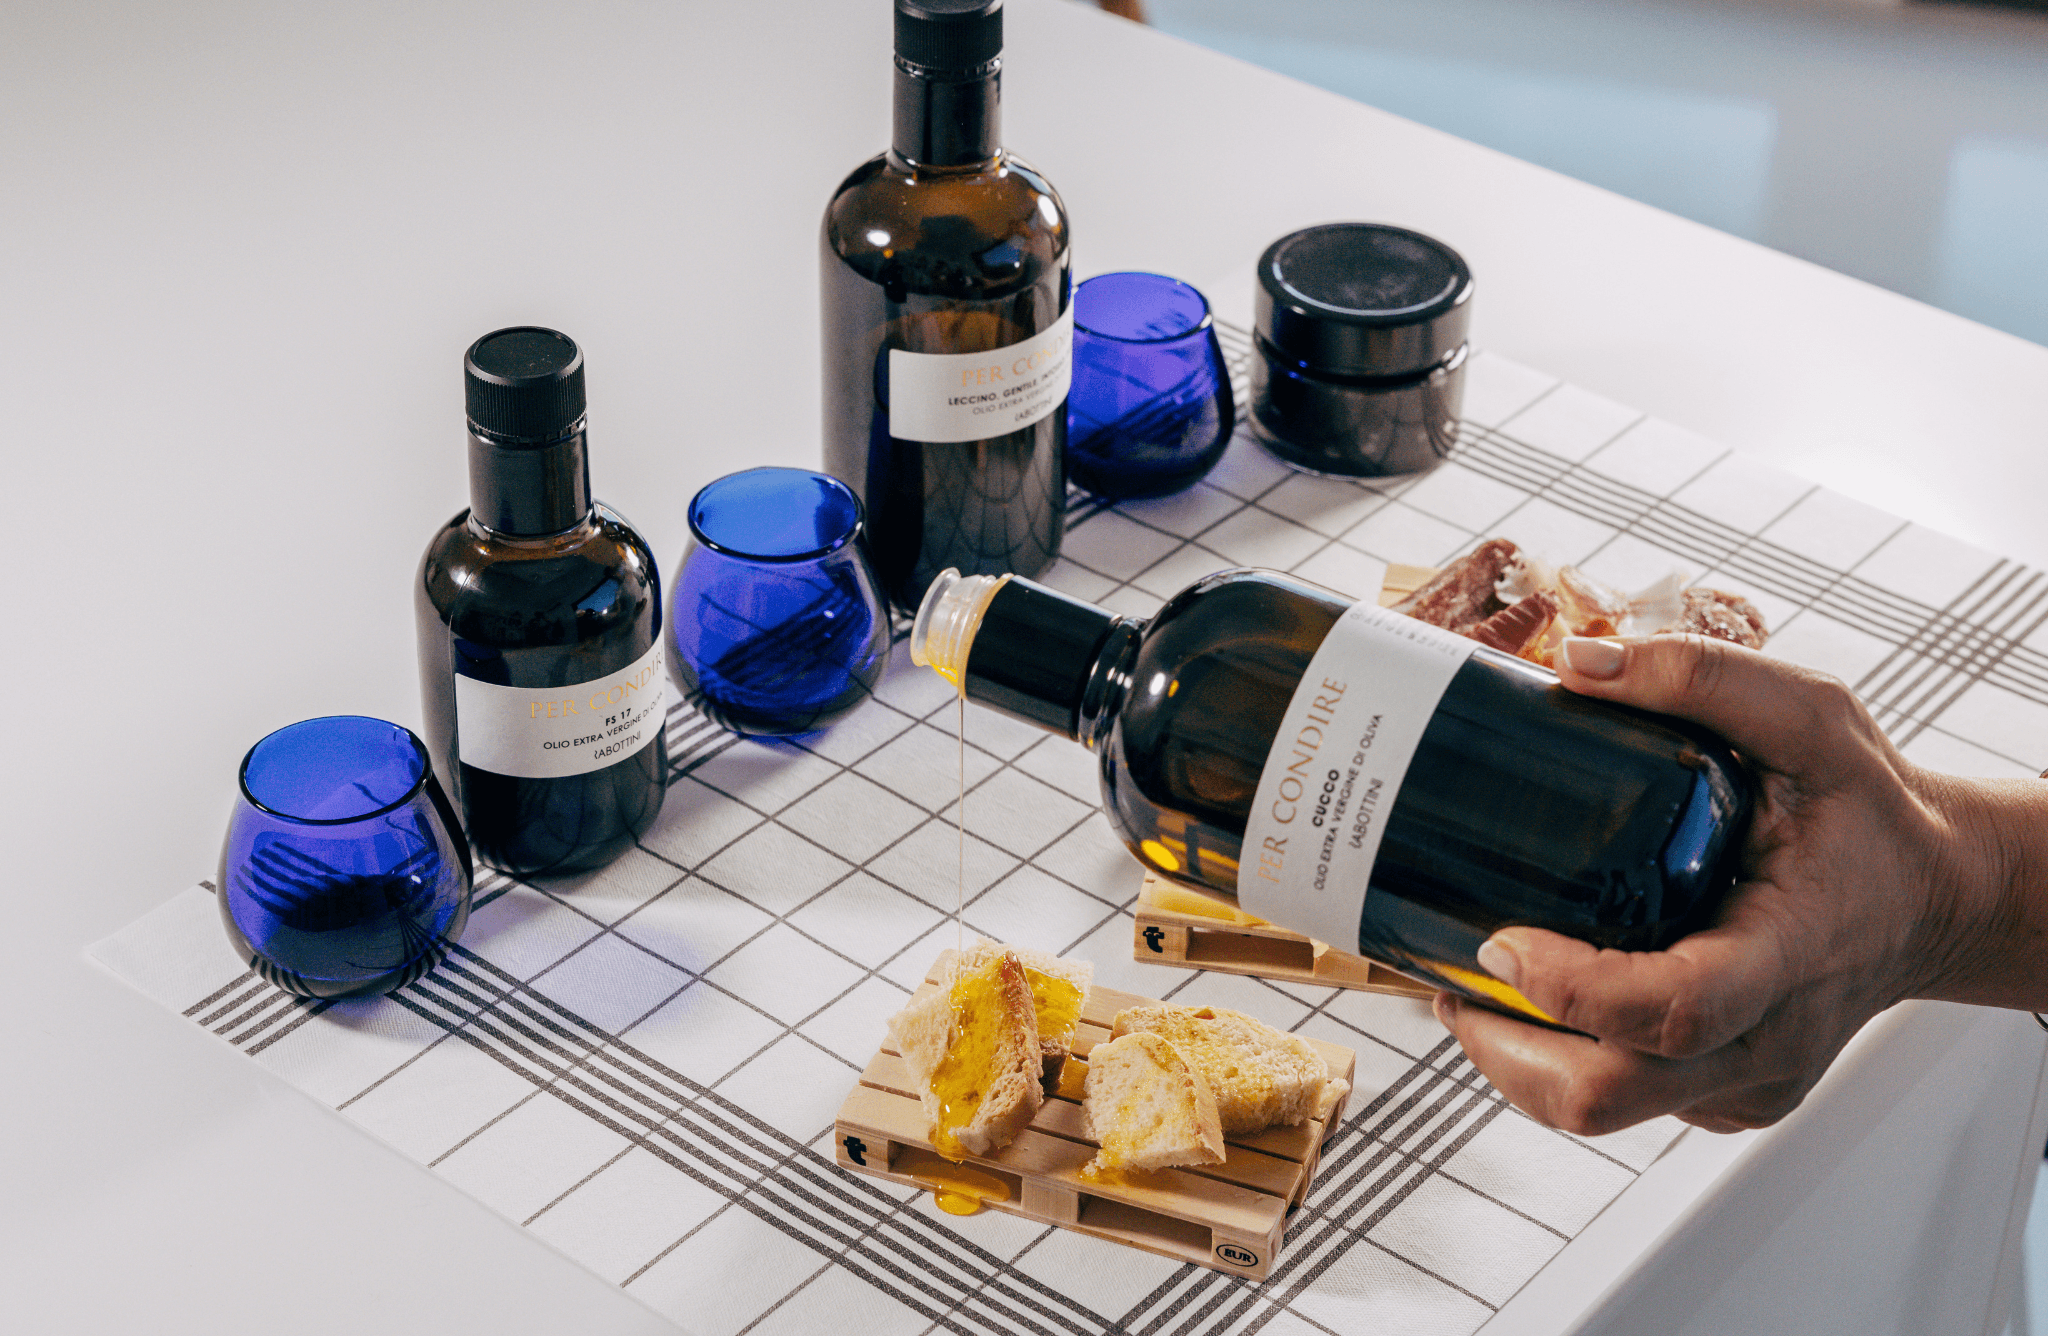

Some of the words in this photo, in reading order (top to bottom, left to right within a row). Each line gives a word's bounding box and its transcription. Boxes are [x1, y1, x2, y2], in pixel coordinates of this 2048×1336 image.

[962, 365, 1004, 387] PER
[972, 404, 996, 416] OLIO
[998, 397, 1023, 411] EXTRA
[530, 699, 580, 718] PER
[605, 715, 617, 727] FS
[620, 707, 632, 720] 17
[543, 740, 570, 750] OLIO
[573, 732, 604, 747] EXTRA
[606, 713, 642, 736] VERGINE
[642, 706, 650, 718] DI
[1359, 713, 1384, 749] OLIVA
[1271, 677, 1348, 825] CONDIRE
[1352, 750, 1367, 766] DI
[1312, 768, 1341, 828] CUCCO
[1332, 766, 1360, 823] VERGINE
[1257, 836, 1289, 883] PER
[1320, 826, 1339, 863] EXTRA
[1314, 863, 1329, 891] OLIO
[1224, 1248, 1252, 1263] EUR
